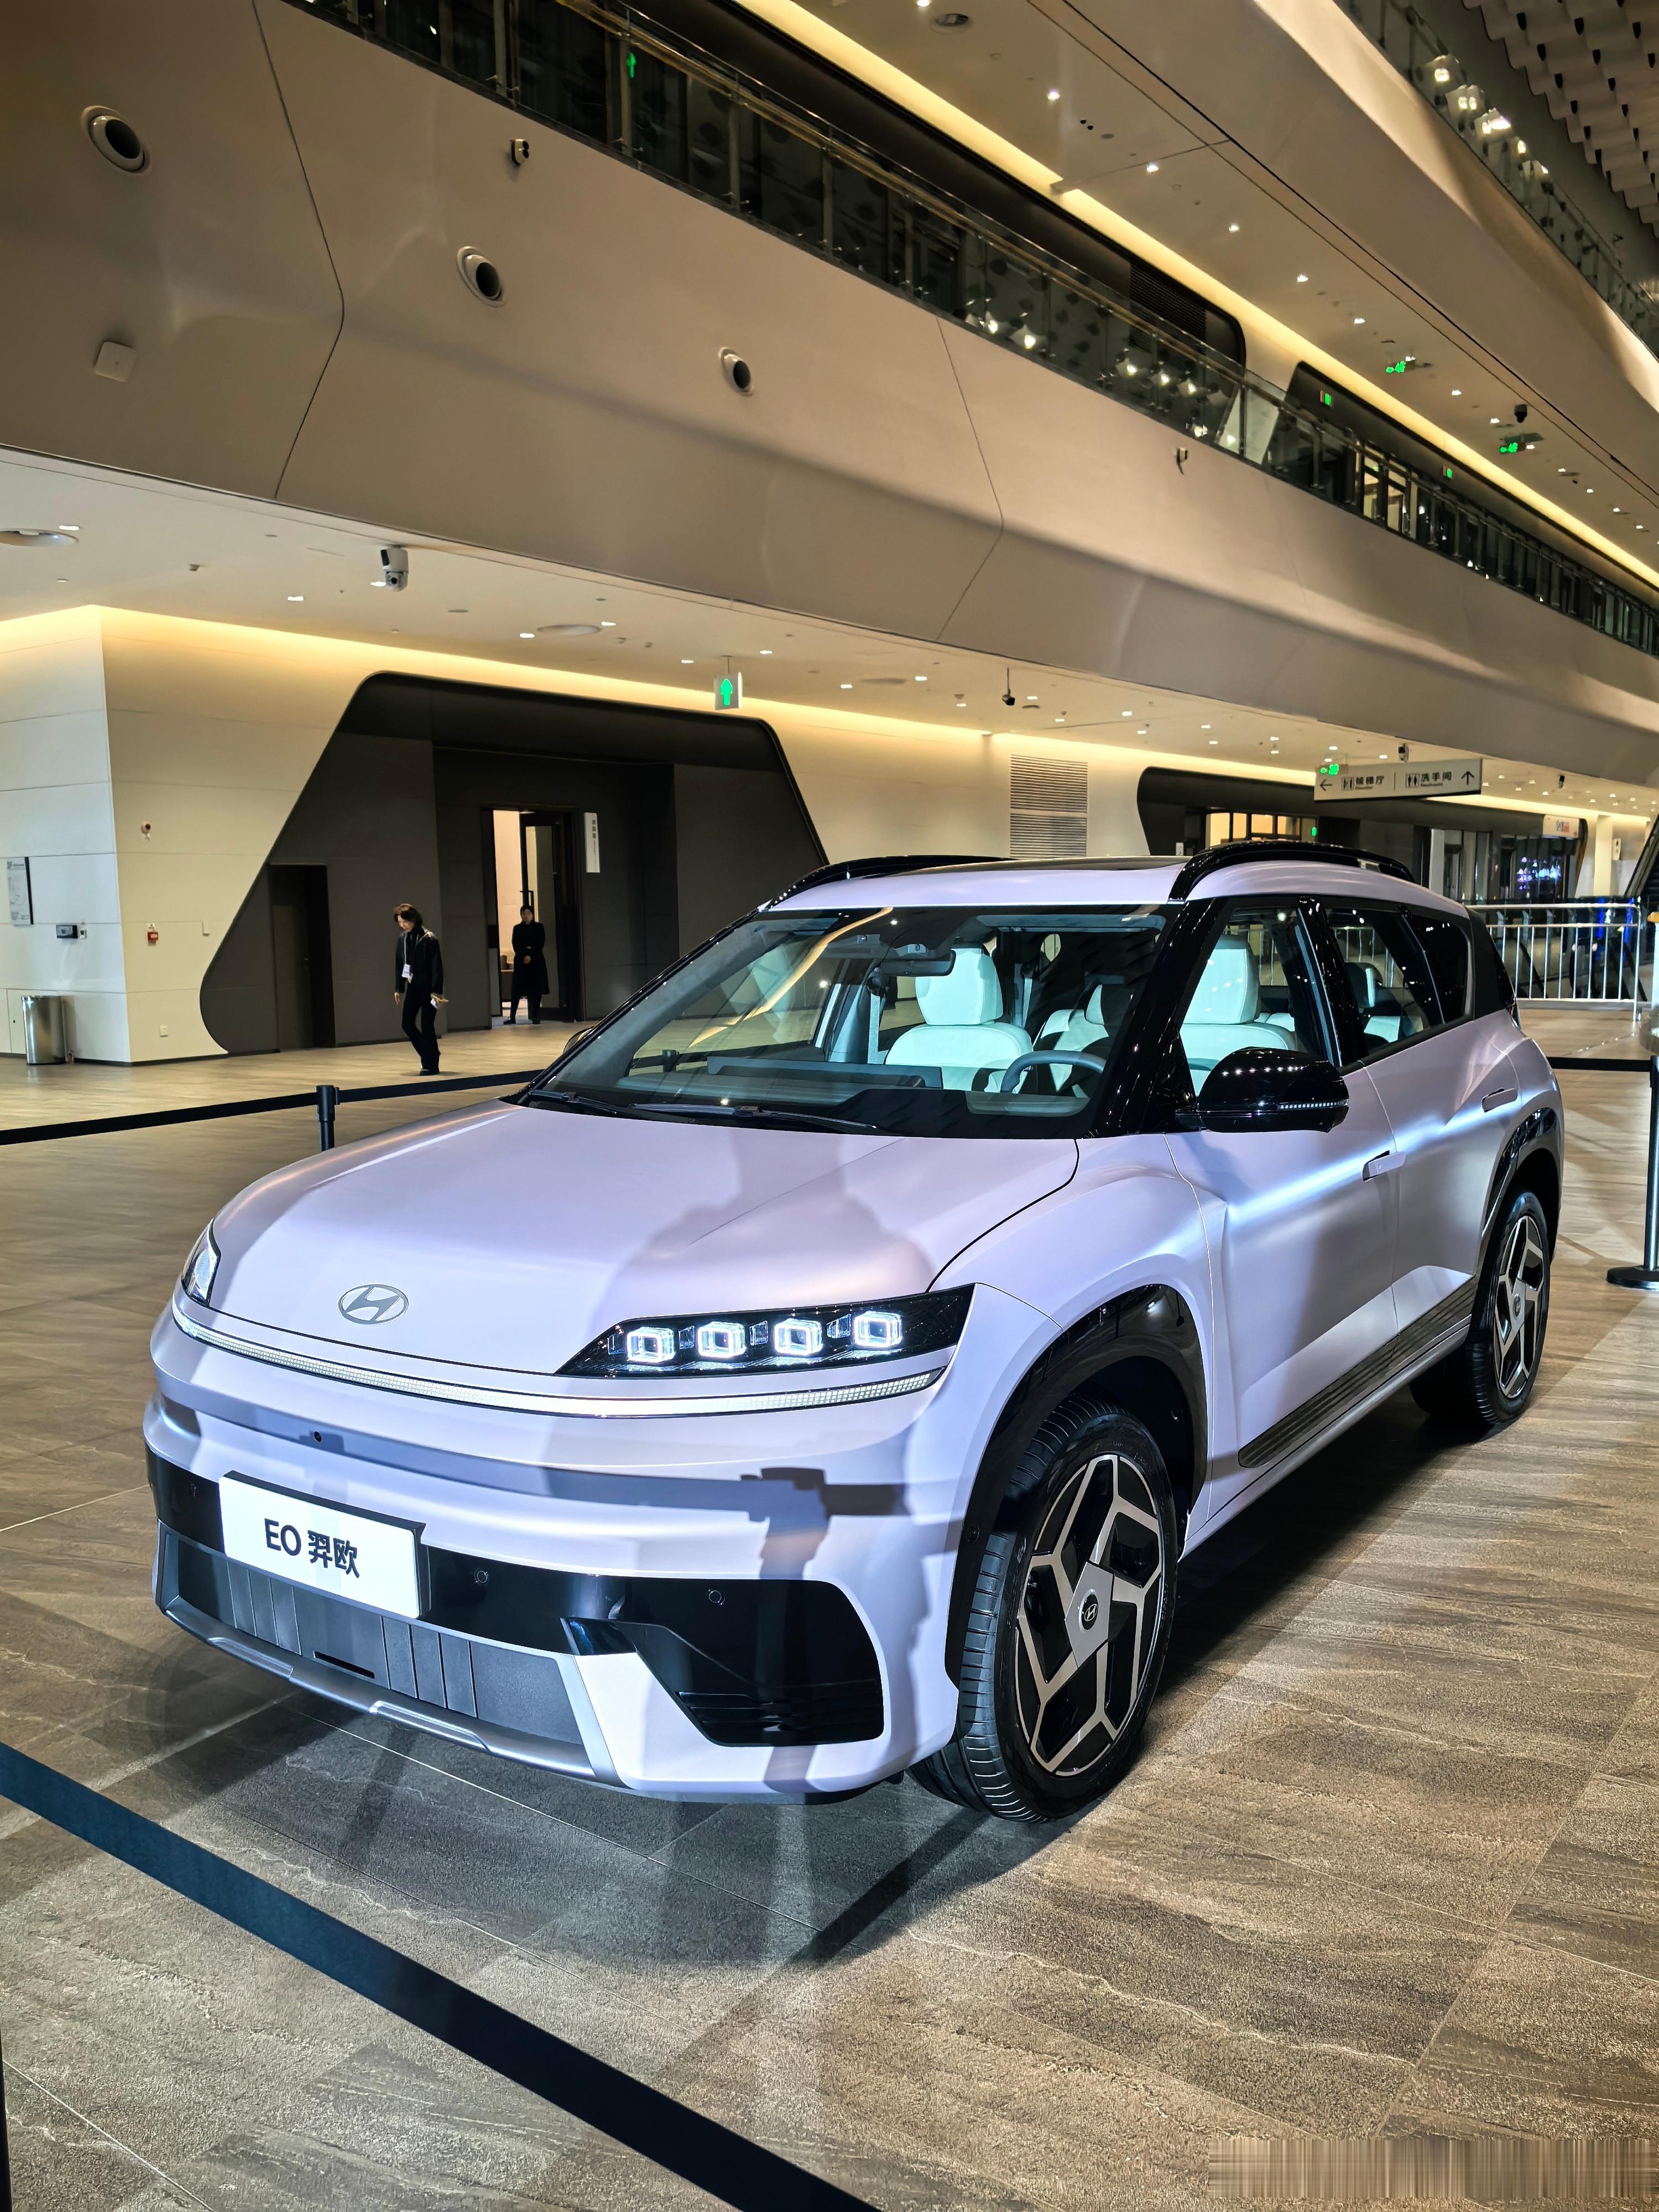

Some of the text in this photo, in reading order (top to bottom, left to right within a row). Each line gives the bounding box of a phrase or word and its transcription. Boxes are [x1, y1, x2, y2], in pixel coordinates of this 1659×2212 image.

[1421, 771, 1452, 782] 洗手间
[264, 1518, 360, 1578] EO 羿欧
